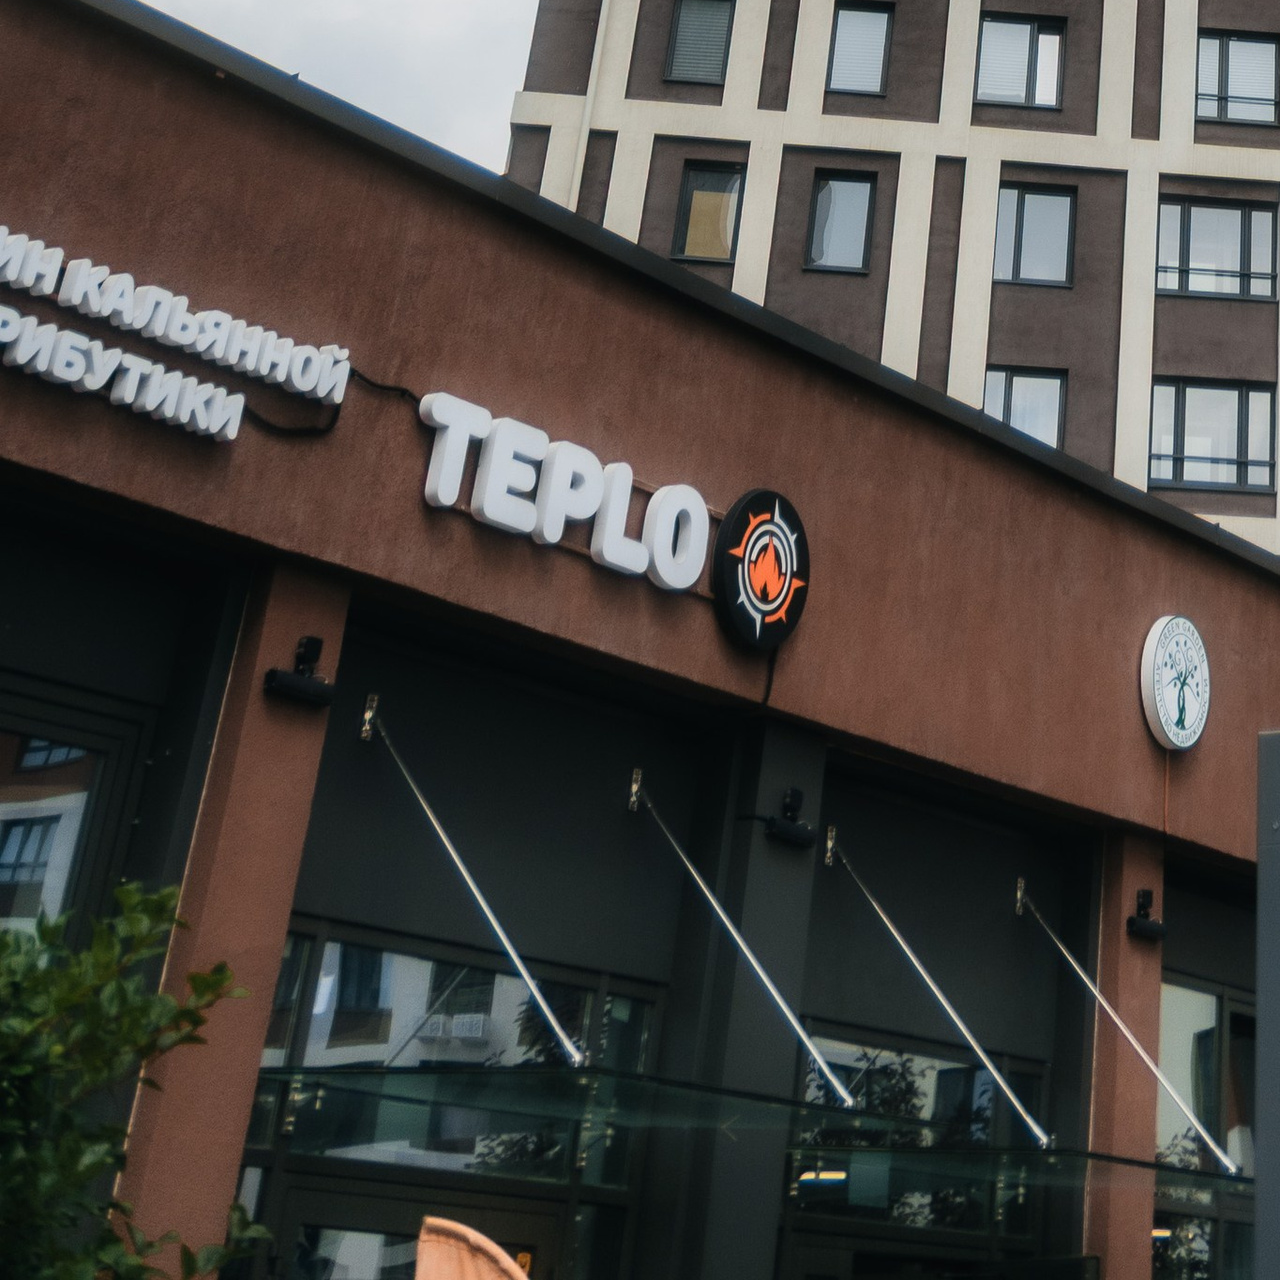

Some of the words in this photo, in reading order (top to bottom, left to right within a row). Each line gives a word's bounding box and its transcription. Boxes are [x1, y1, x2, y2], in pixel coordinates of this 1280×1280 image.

[58, 258, 352, 404] КАЛЬЯННОЙ
[419, 392, 710, 590] TEPLO
[1159, 620, 1181, 650] GREEN
